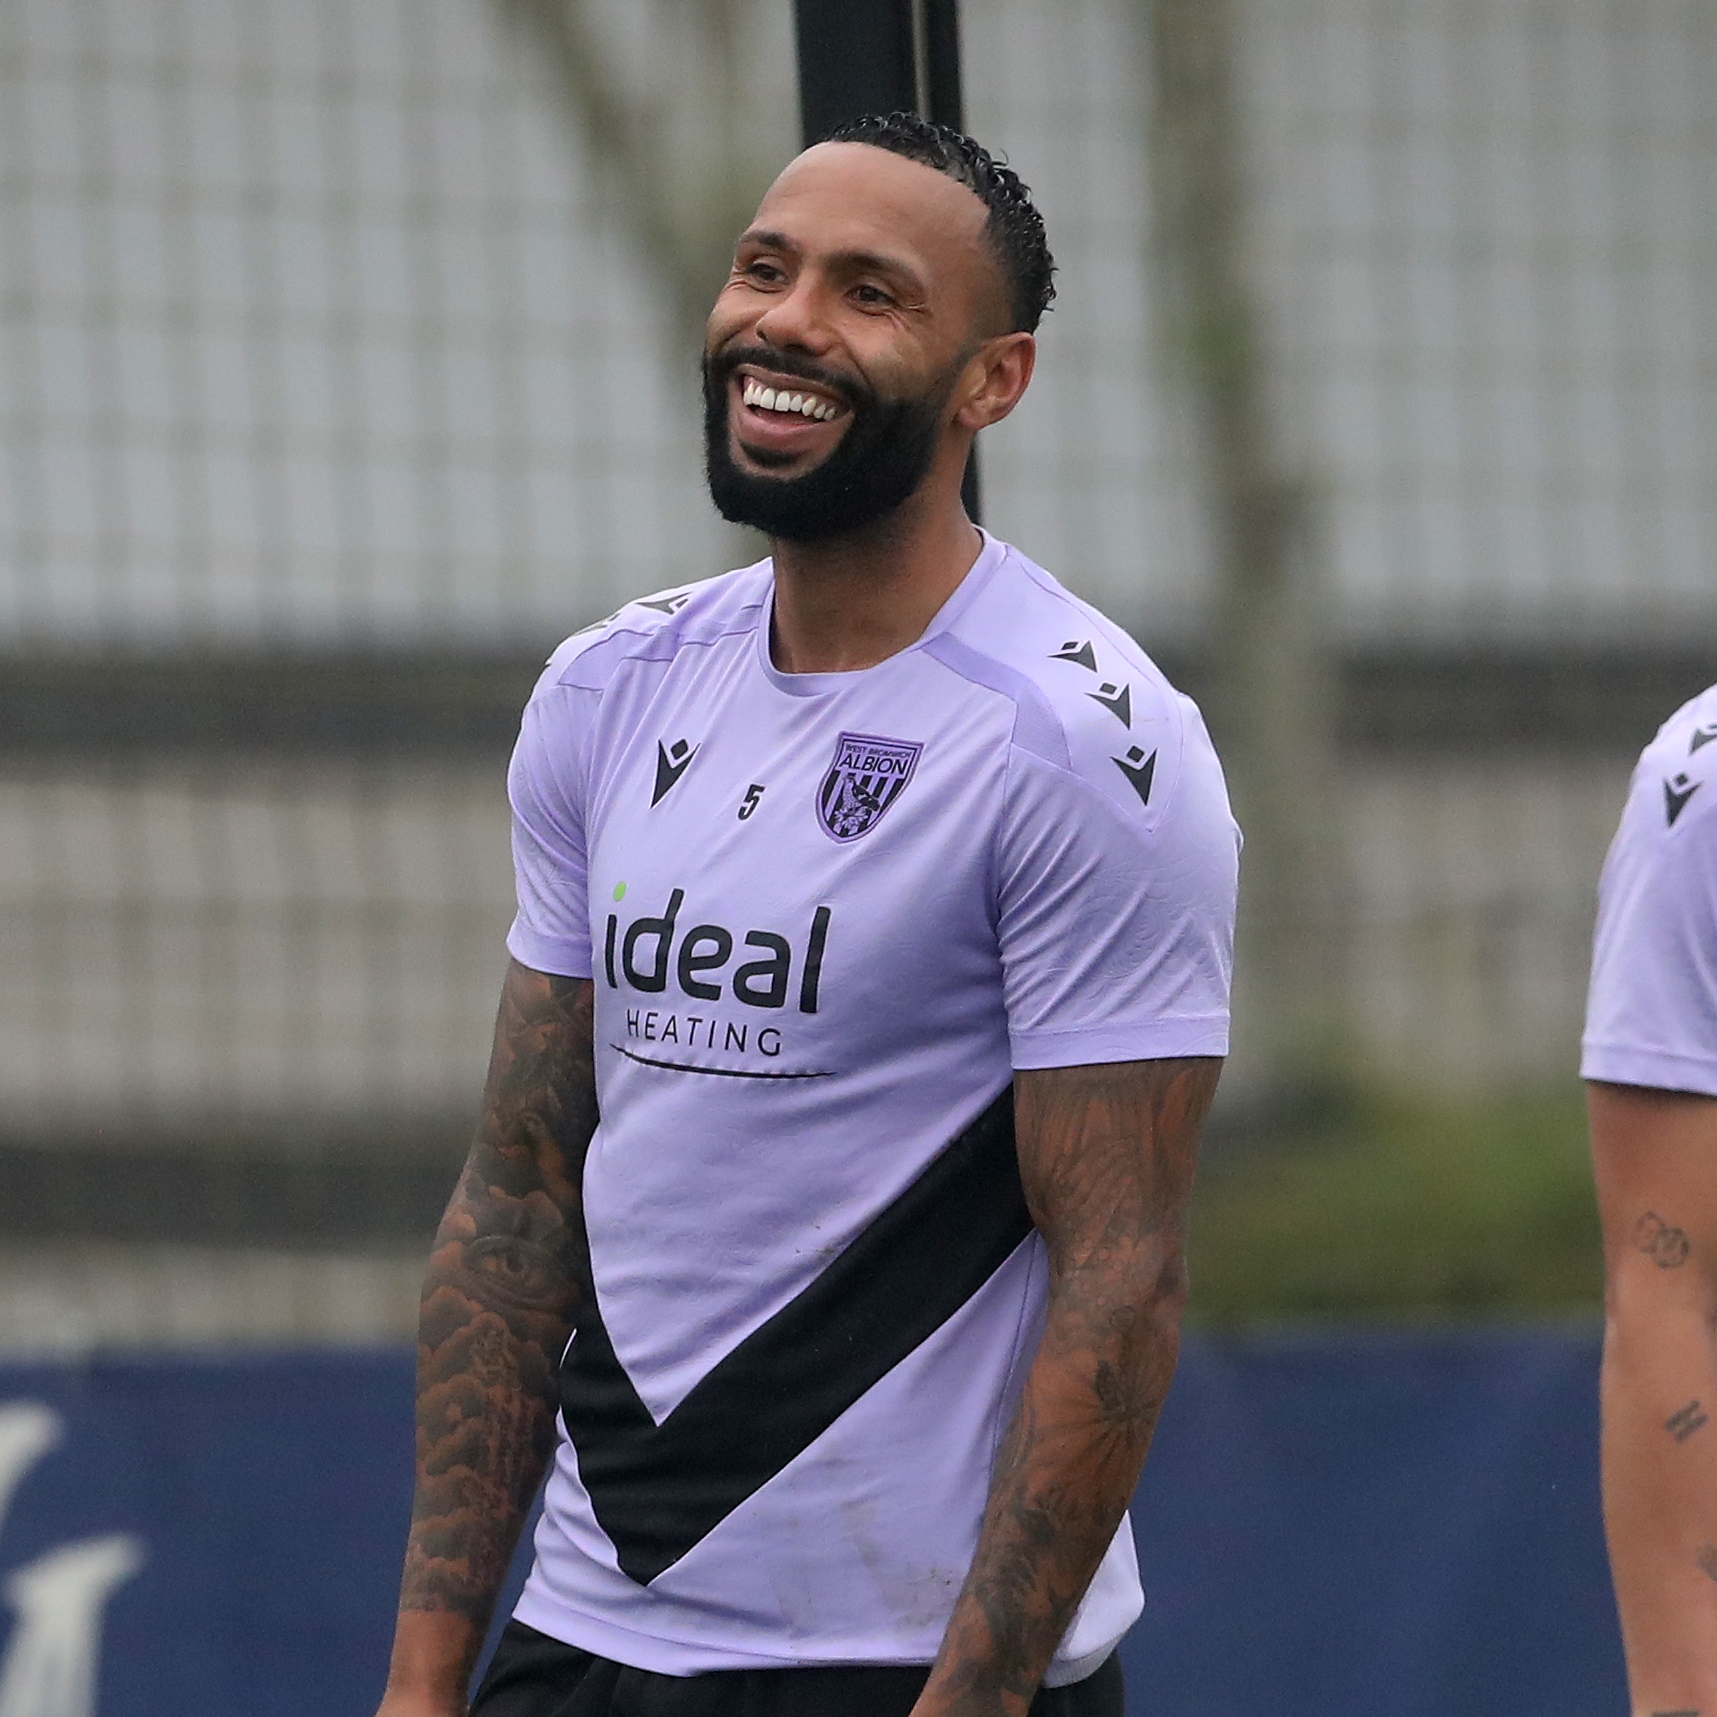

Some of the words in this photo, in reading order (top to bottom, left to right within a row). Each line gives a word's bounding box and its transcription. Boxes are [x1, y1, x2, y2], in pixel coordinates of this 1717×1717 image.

[839, 752, 909, 775] ALBION
[738, 783, 765, 820] 5
[604, 881, 831, 1014] ideal
[626, 1008, 782, 1057] HEATING
